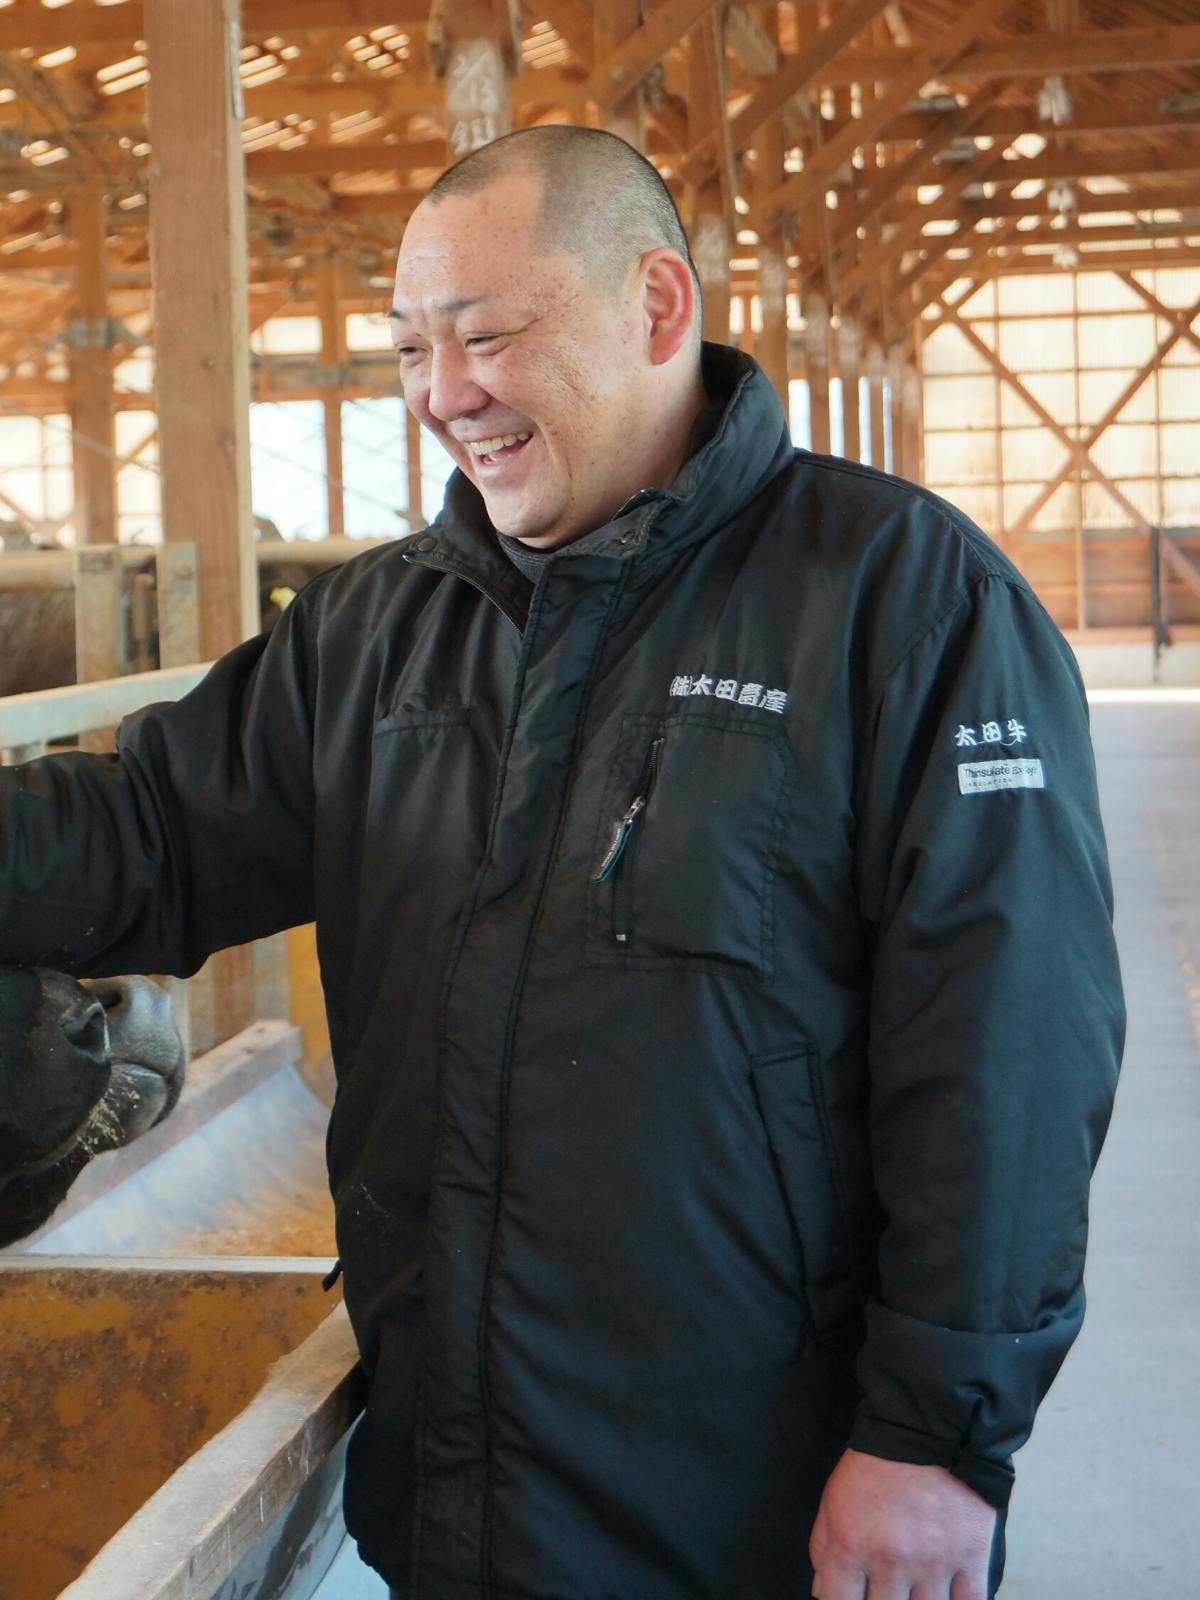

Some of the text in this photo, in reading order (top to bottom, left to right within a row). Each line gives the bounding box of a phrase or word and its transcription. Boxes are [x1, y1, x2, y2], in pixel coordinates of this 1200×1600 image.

[954, 718, 1028, 746] 太田牛
[963, 763, 1010, 778] Thinsulate
